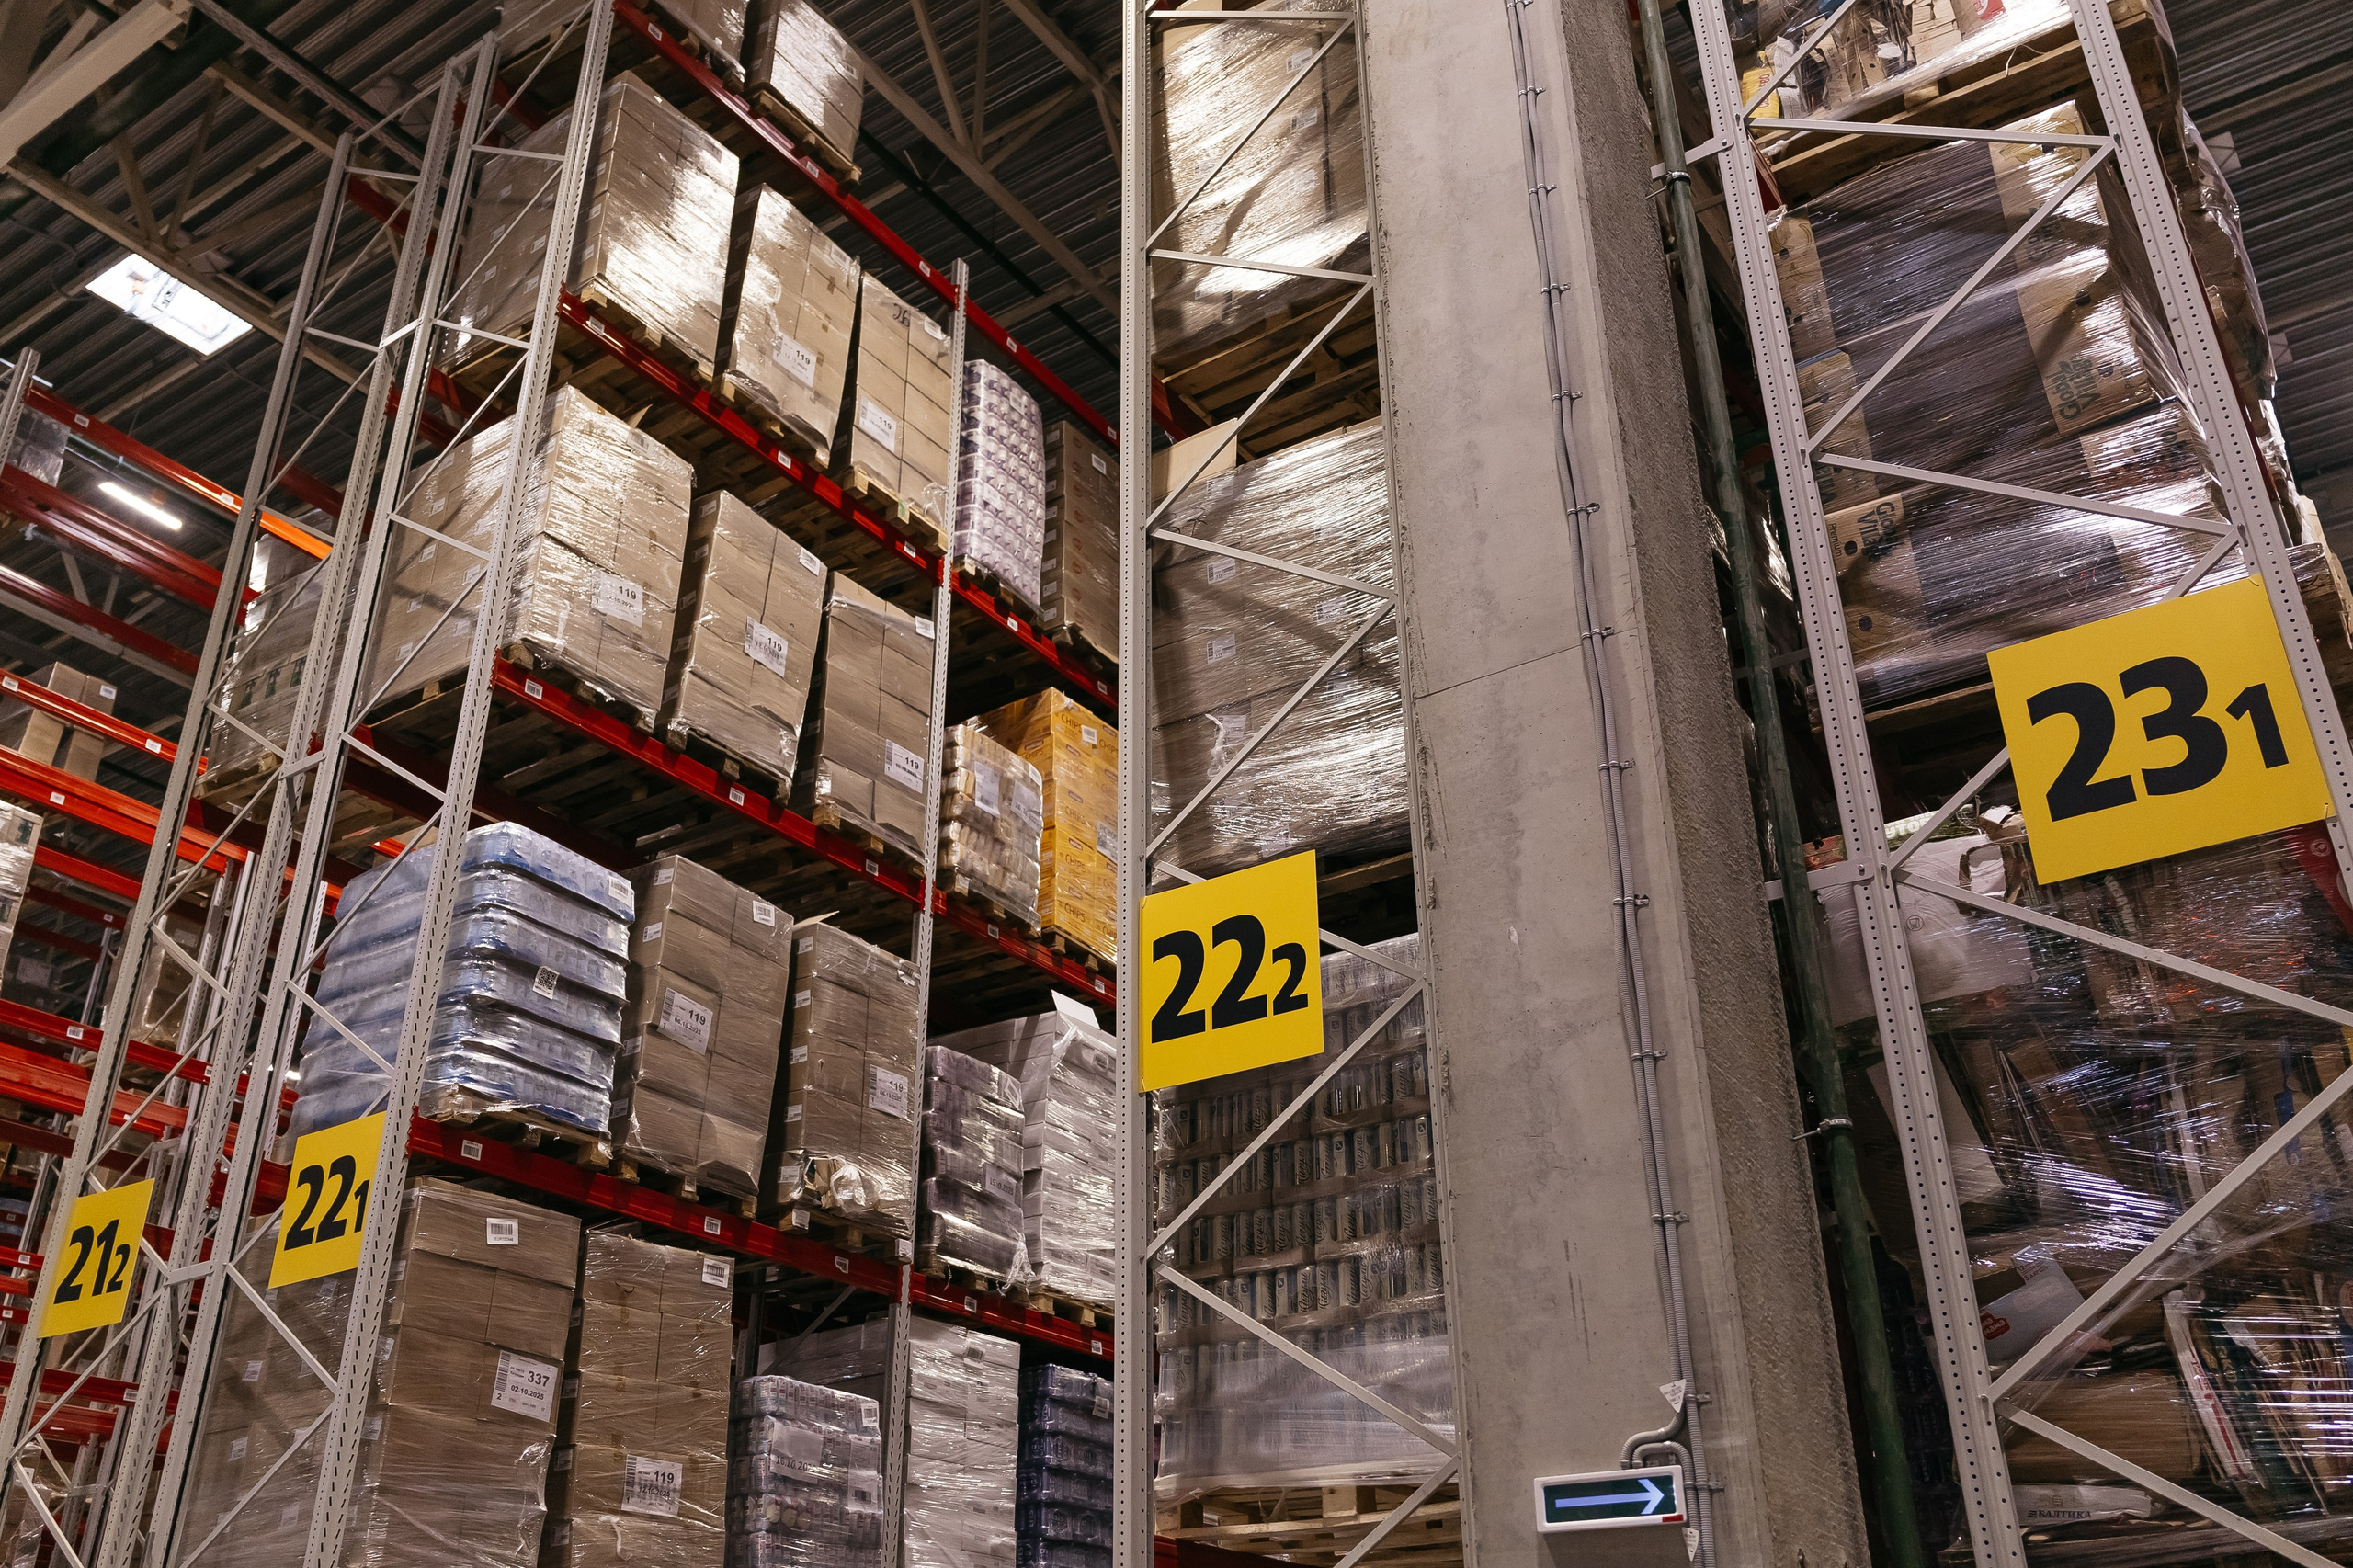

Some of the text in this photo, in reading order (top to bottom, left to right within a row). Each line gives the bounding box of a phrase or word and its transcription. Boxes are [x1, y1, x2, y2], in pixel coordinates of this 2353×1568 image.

[796, 350, 811, 365] 119
[879, 416, 892, 431] 119
[1827, 522, 1843, 558] Premium
[619, 585, 637, 600] 119
[767, 637, 782, 652] 119
[905, 756, 919, 770] 119
[1064, 853, 1086, 873] CHIPS
[1063, 903, 1086, 923] CHIPS
[688, 1009, 707, 1026] 119
[889, 1080, 904, 1093] 119
[527, 1370, 550, 1387] 337
[510, 1384, 544, 1401] 02.10.2025
[654, 1470, 675, 1484] 119
[2038, 1510, 2093, 1520] БАЛТИКА
